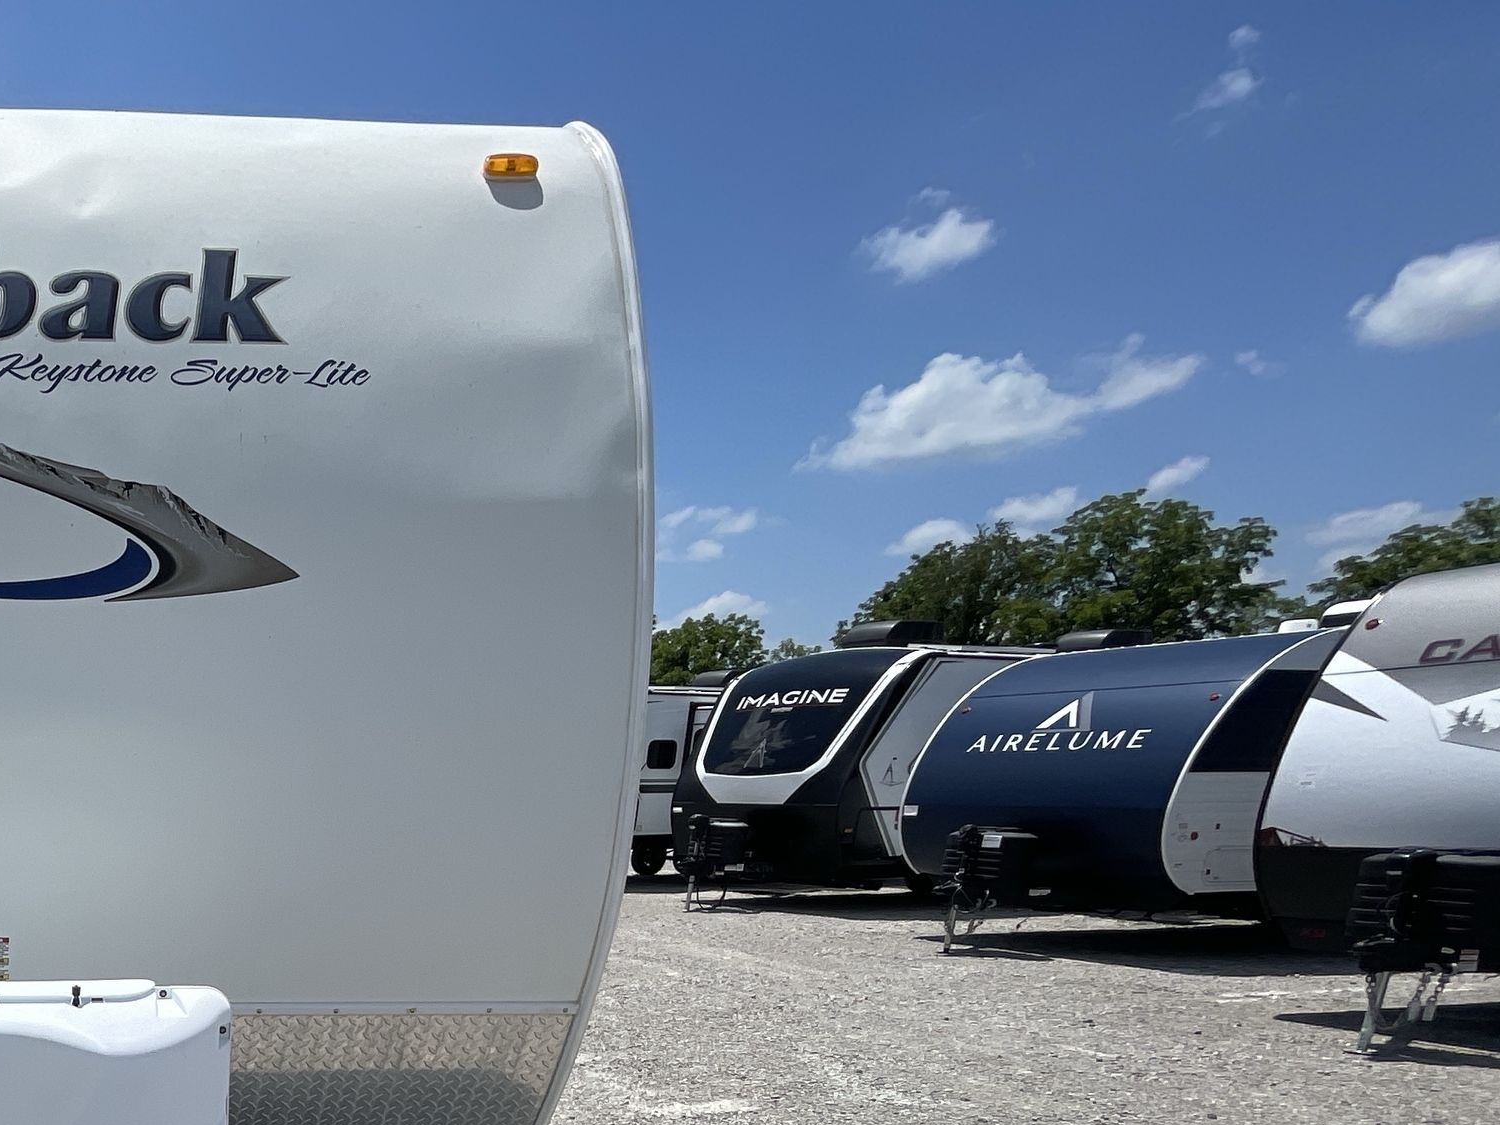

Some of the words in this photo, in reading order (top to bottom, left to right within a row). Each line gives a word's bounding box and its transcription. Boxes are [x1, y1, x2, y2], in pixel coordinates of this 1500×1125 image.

[170, 359, 372, 392] Super-Lite
[736, 687, 850, 711] IMAGINE
[965, 729, 1152, 753] AIRELUME
